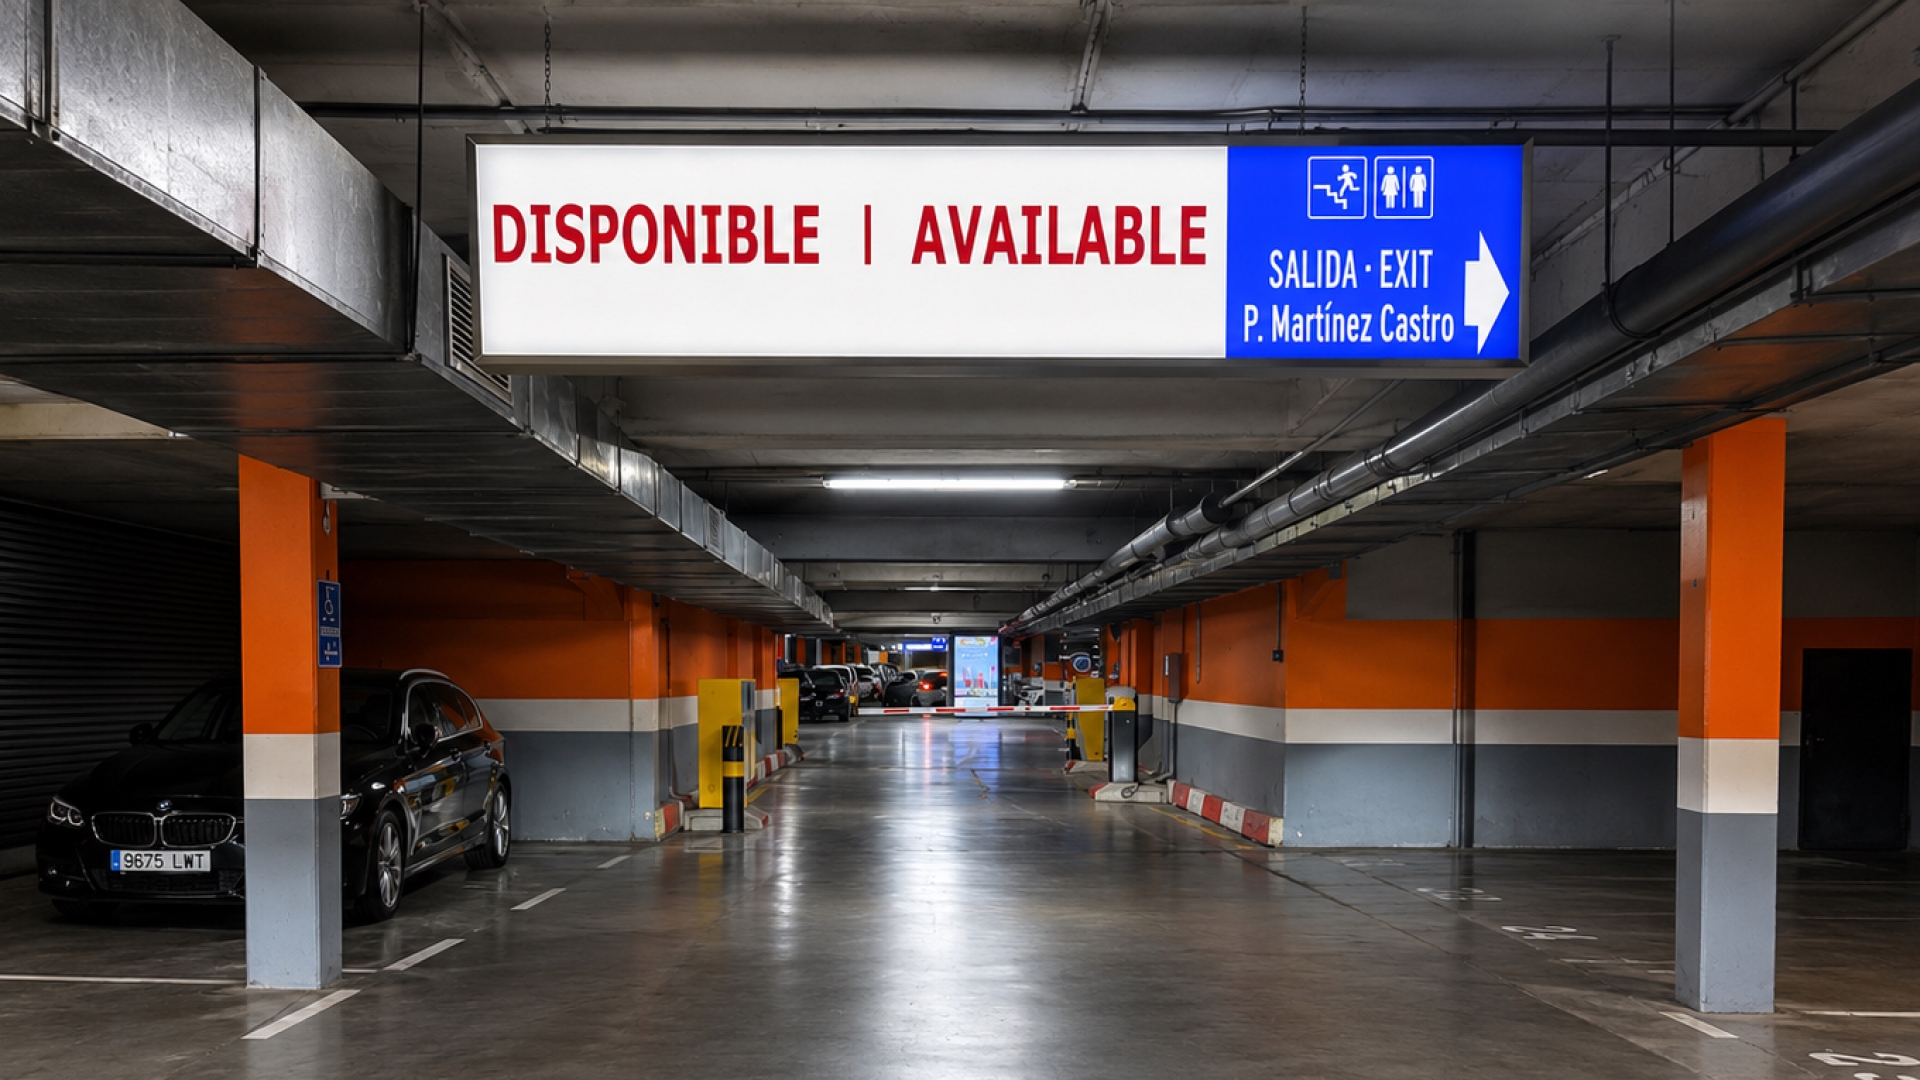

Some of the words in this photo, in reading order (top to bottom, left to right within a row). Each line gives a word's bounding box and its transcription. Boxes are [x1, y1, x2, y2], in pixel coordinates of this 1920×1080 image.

[494, 204, 820, 265] DISPONIBLE
[912, 205, 1207, 266] AVAILABLE
[1268, 249, 1358, 289] SALIDA
[1380, 249, 1434, 289] EXIT
[1243, 304, 1263, 343] P.
[1271, 301, 1373, 343] Martínez
[1380, 303, 1455, 343] Castro
[123, 853, 165, 869] 9675
[172, 853, 204, 869] LWT
